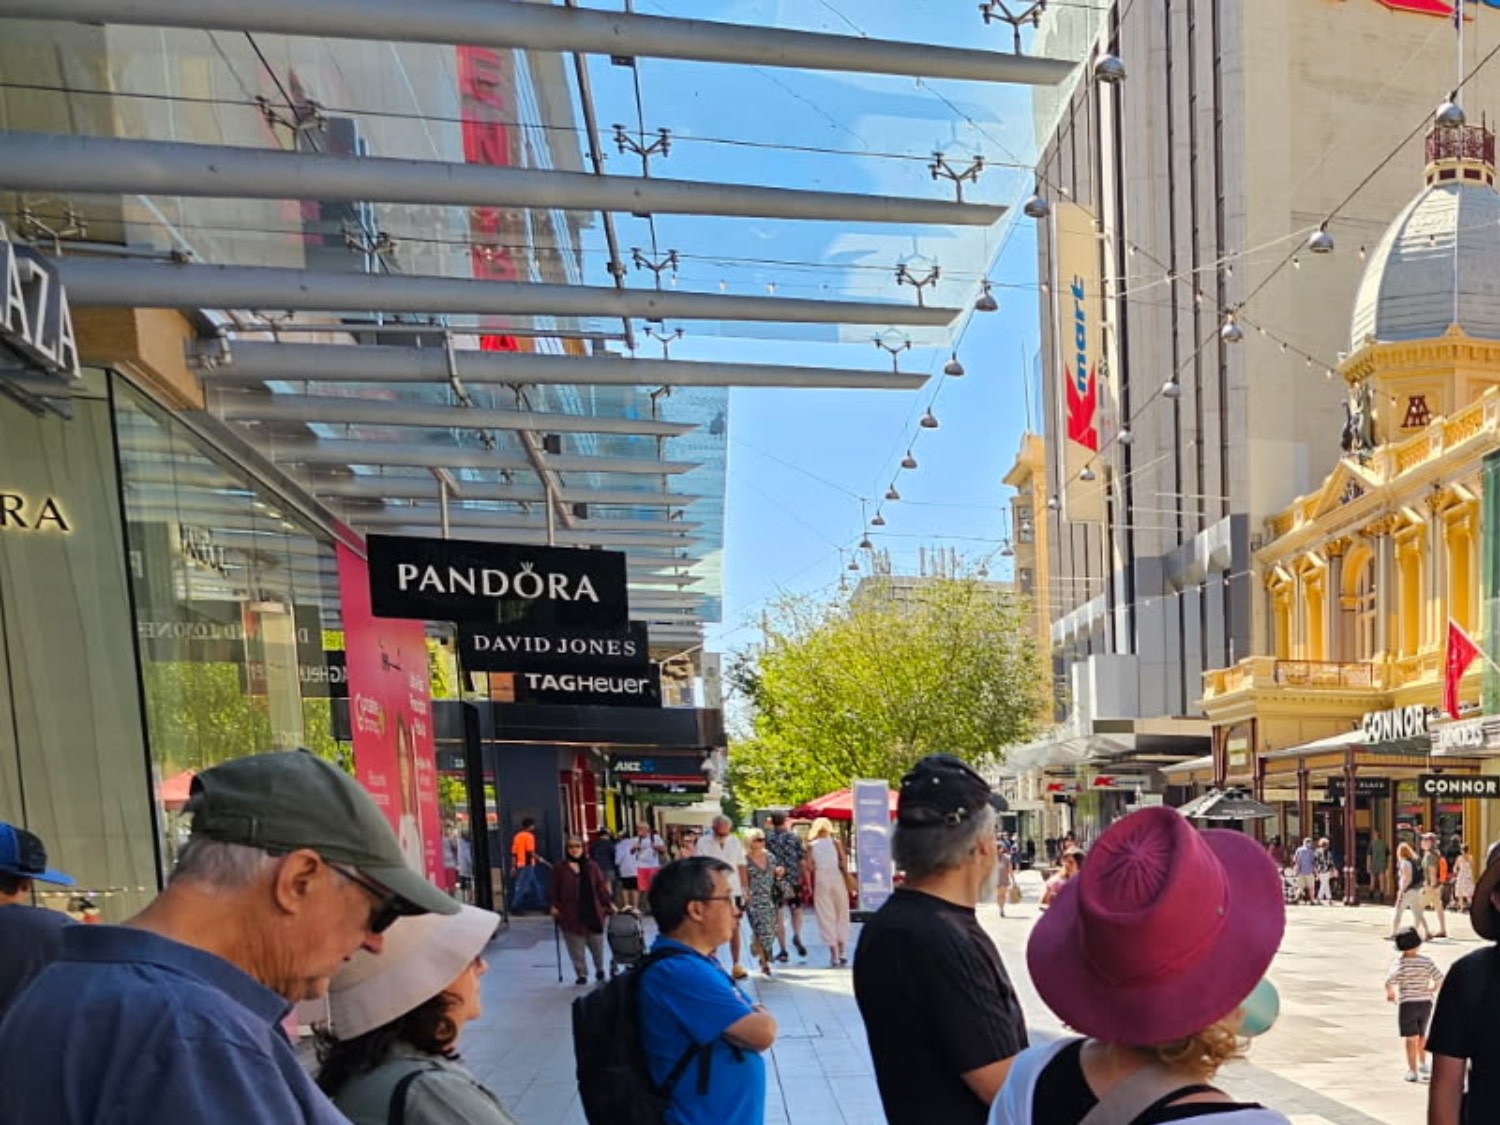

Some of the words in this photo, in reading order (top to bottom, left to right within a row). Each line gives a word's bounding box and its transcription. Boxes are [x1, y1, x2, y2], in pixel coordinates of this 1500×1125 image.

[396, 562, 600, 602] PANDORA
[473, 635, 550, 653] DAVID
[557, 638, 637, 657] JONES
[1363, 704, 1428, 743] CONNOR
[1424, 779, 1497, 794] CONNOR
